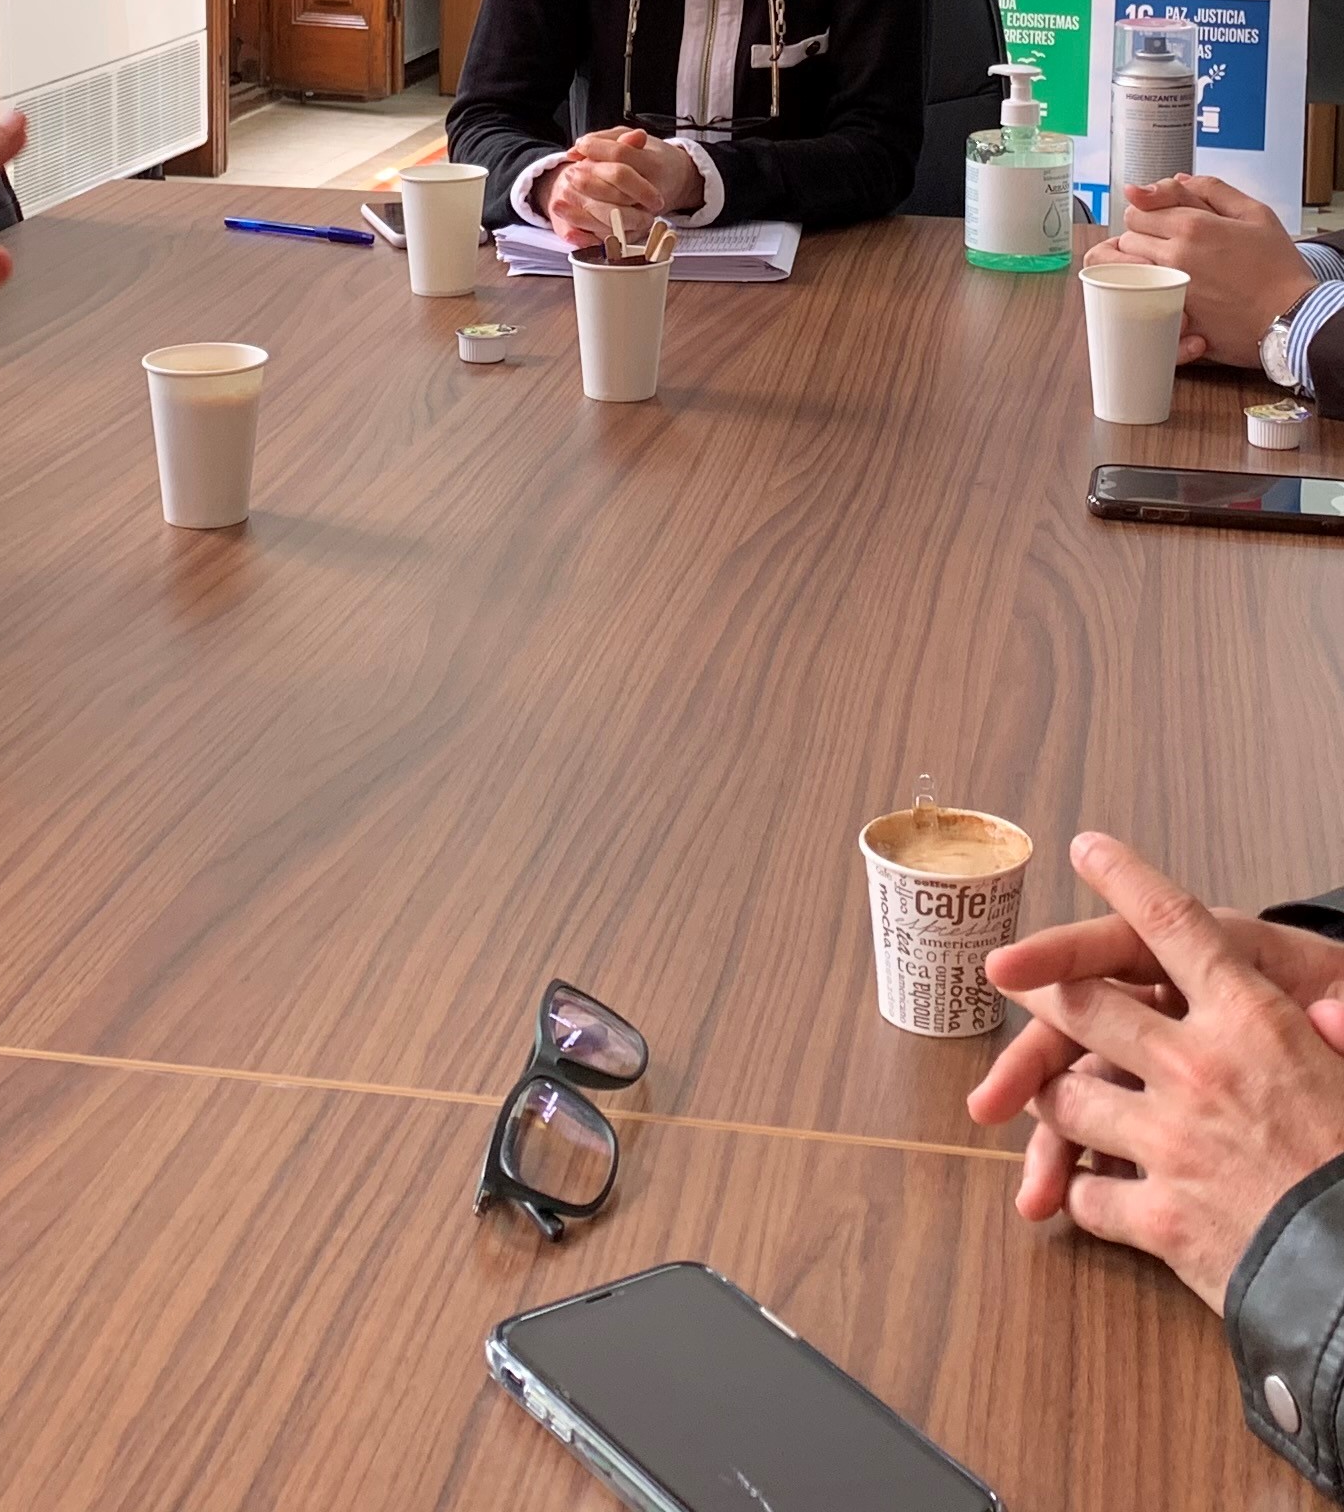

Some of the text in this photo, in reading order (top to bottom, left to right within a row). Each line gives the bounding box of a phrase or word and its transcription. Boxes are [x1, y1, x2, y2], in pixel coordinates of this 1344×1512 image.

[1006, 12, 1080, 31] ECOSISTEMAS
[1194, 7, 1246, 26] JUSTICIA
[1004, 29, 1055, 46] RRESTRES
[1197, 26, 1259, 44] ITUCIONES
[879, 883, 894, 948] mocha
[919, 937, 997, 950] americano
[913, 948, 988, 964] coffee
[896, 957, 932, 979] tea
[908, 981, 931, 1030] mocha
[933, 965, 947, 1033] americano
[948, 966, 967, 1033] mocha
[965, 965, 992, 1030] coffee
